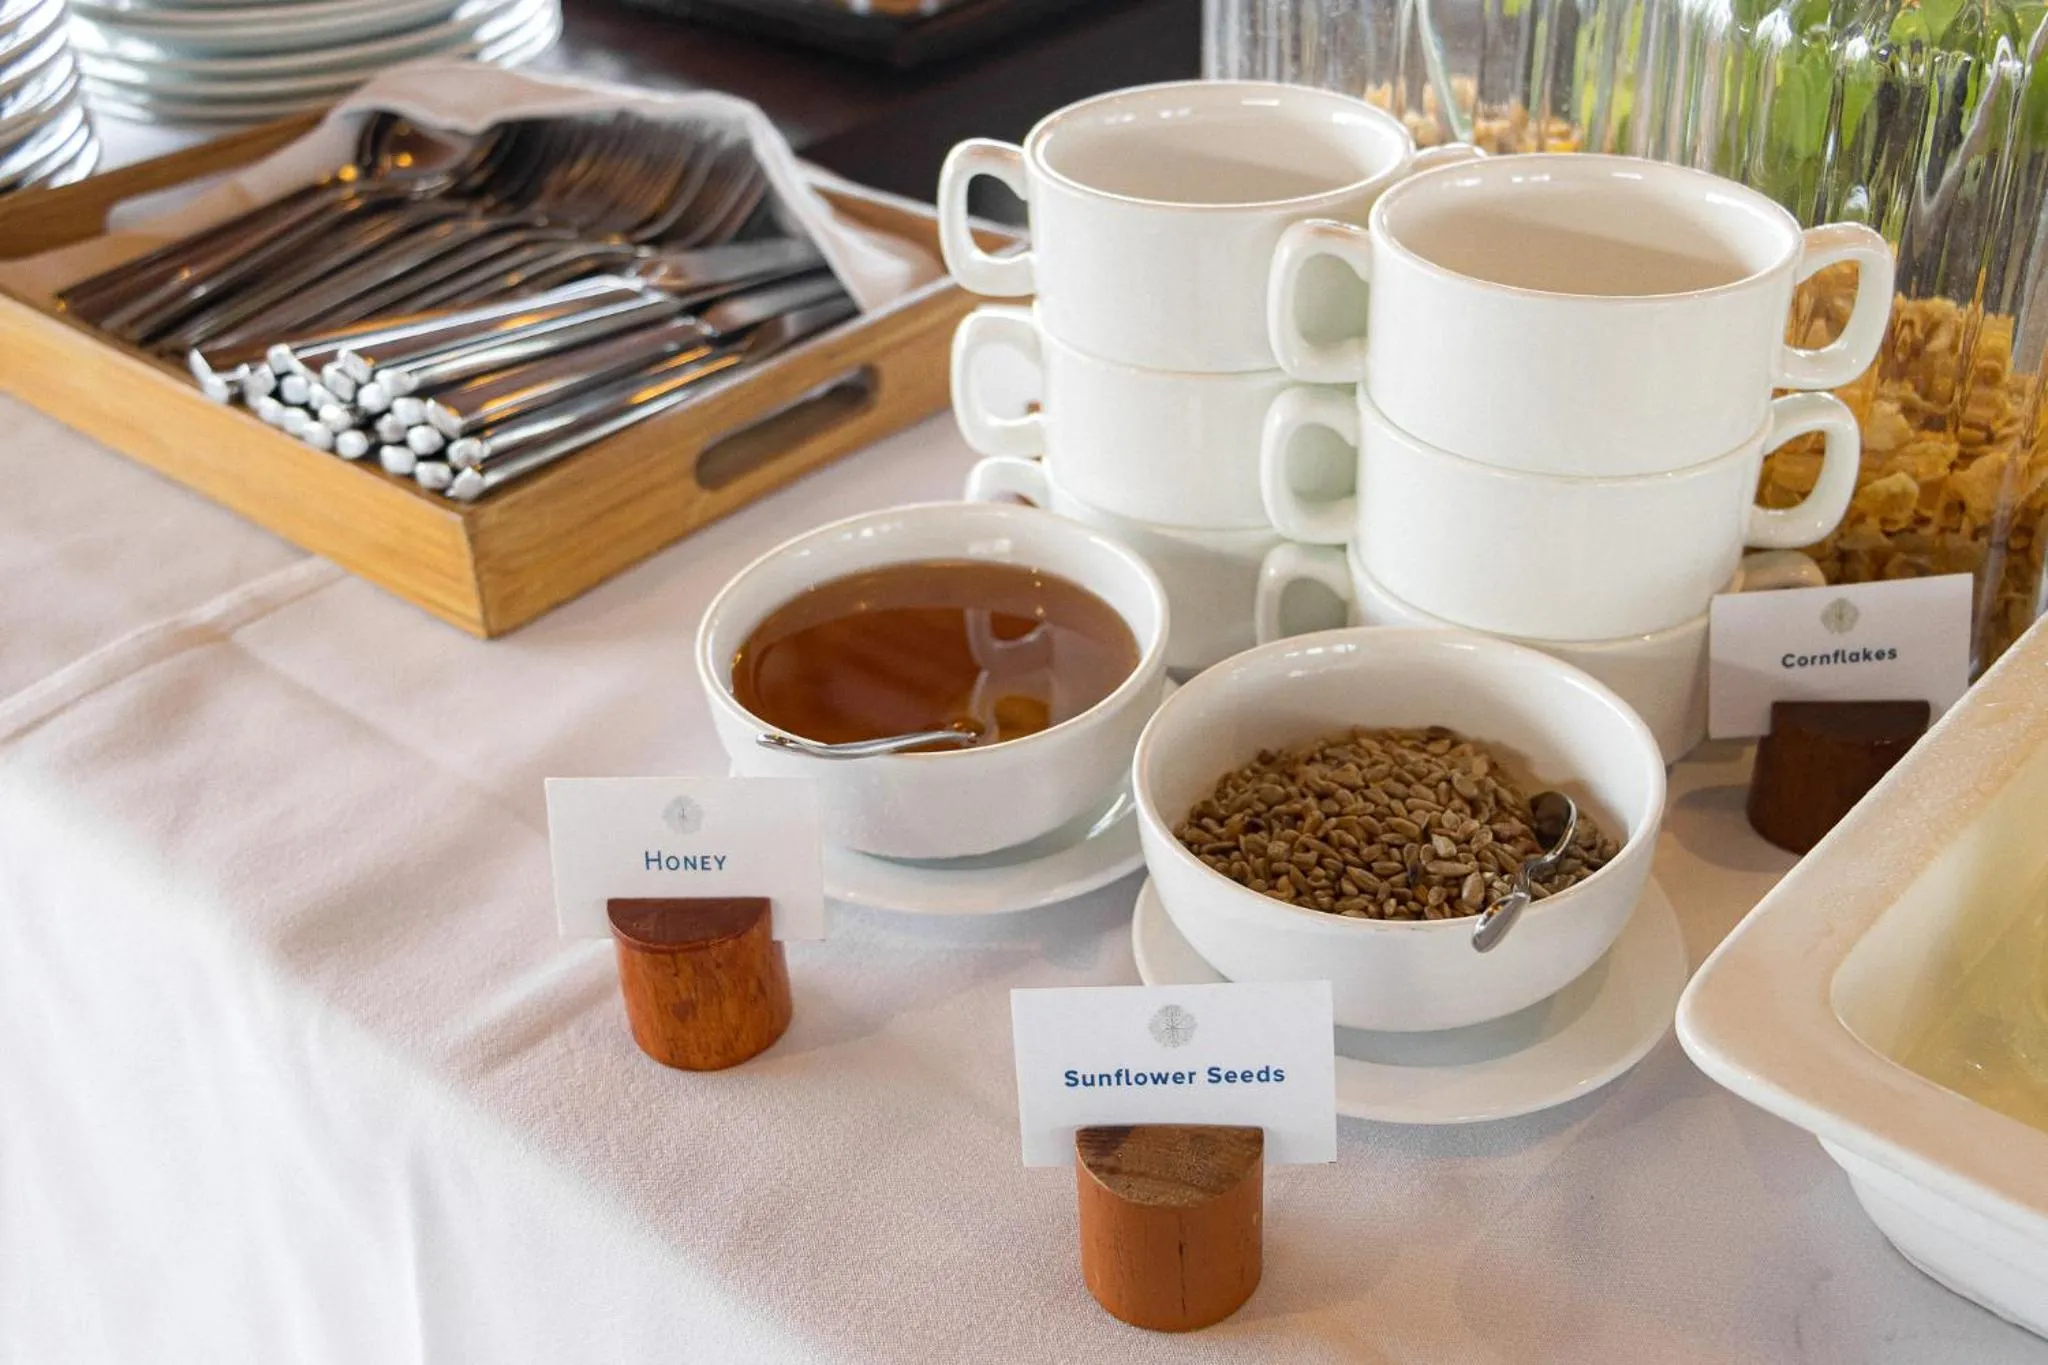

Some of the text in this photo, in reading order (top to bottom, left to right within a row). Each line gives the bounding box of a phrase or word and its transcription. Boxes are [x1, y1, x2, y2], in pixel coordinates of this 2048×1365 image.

[1780, 647, 1898, 669] Cornflakes
[644, 850, 727, 871] HONEY
[1063, 1064, 1286, 1087] Sunflower Seeds
